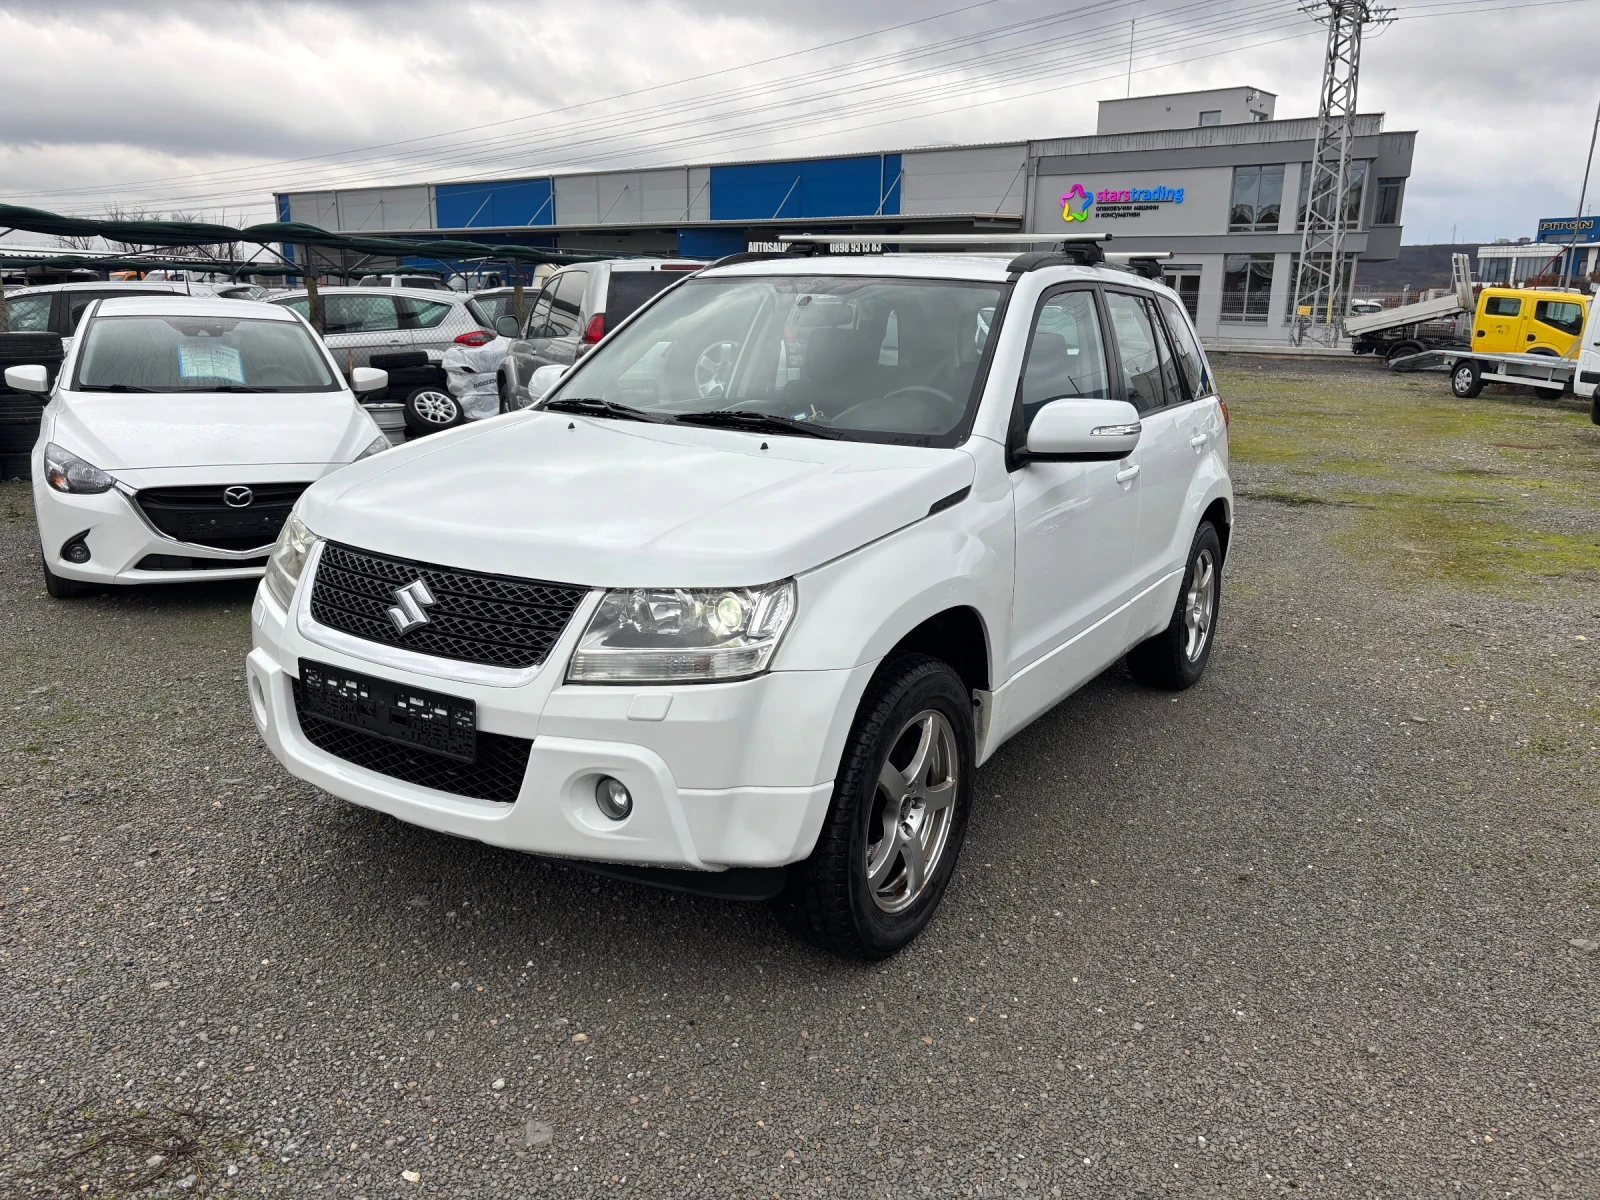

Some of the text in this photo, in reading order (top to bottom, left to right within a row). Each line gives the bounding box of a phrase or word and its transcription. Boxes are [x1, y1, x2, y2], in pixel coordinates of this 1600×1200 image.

[1096, 185, 1184, 203] starstrading
[1540, 220, 1593, 230] PITON
[830, 242, 881, 253] 0898 93 13 83
